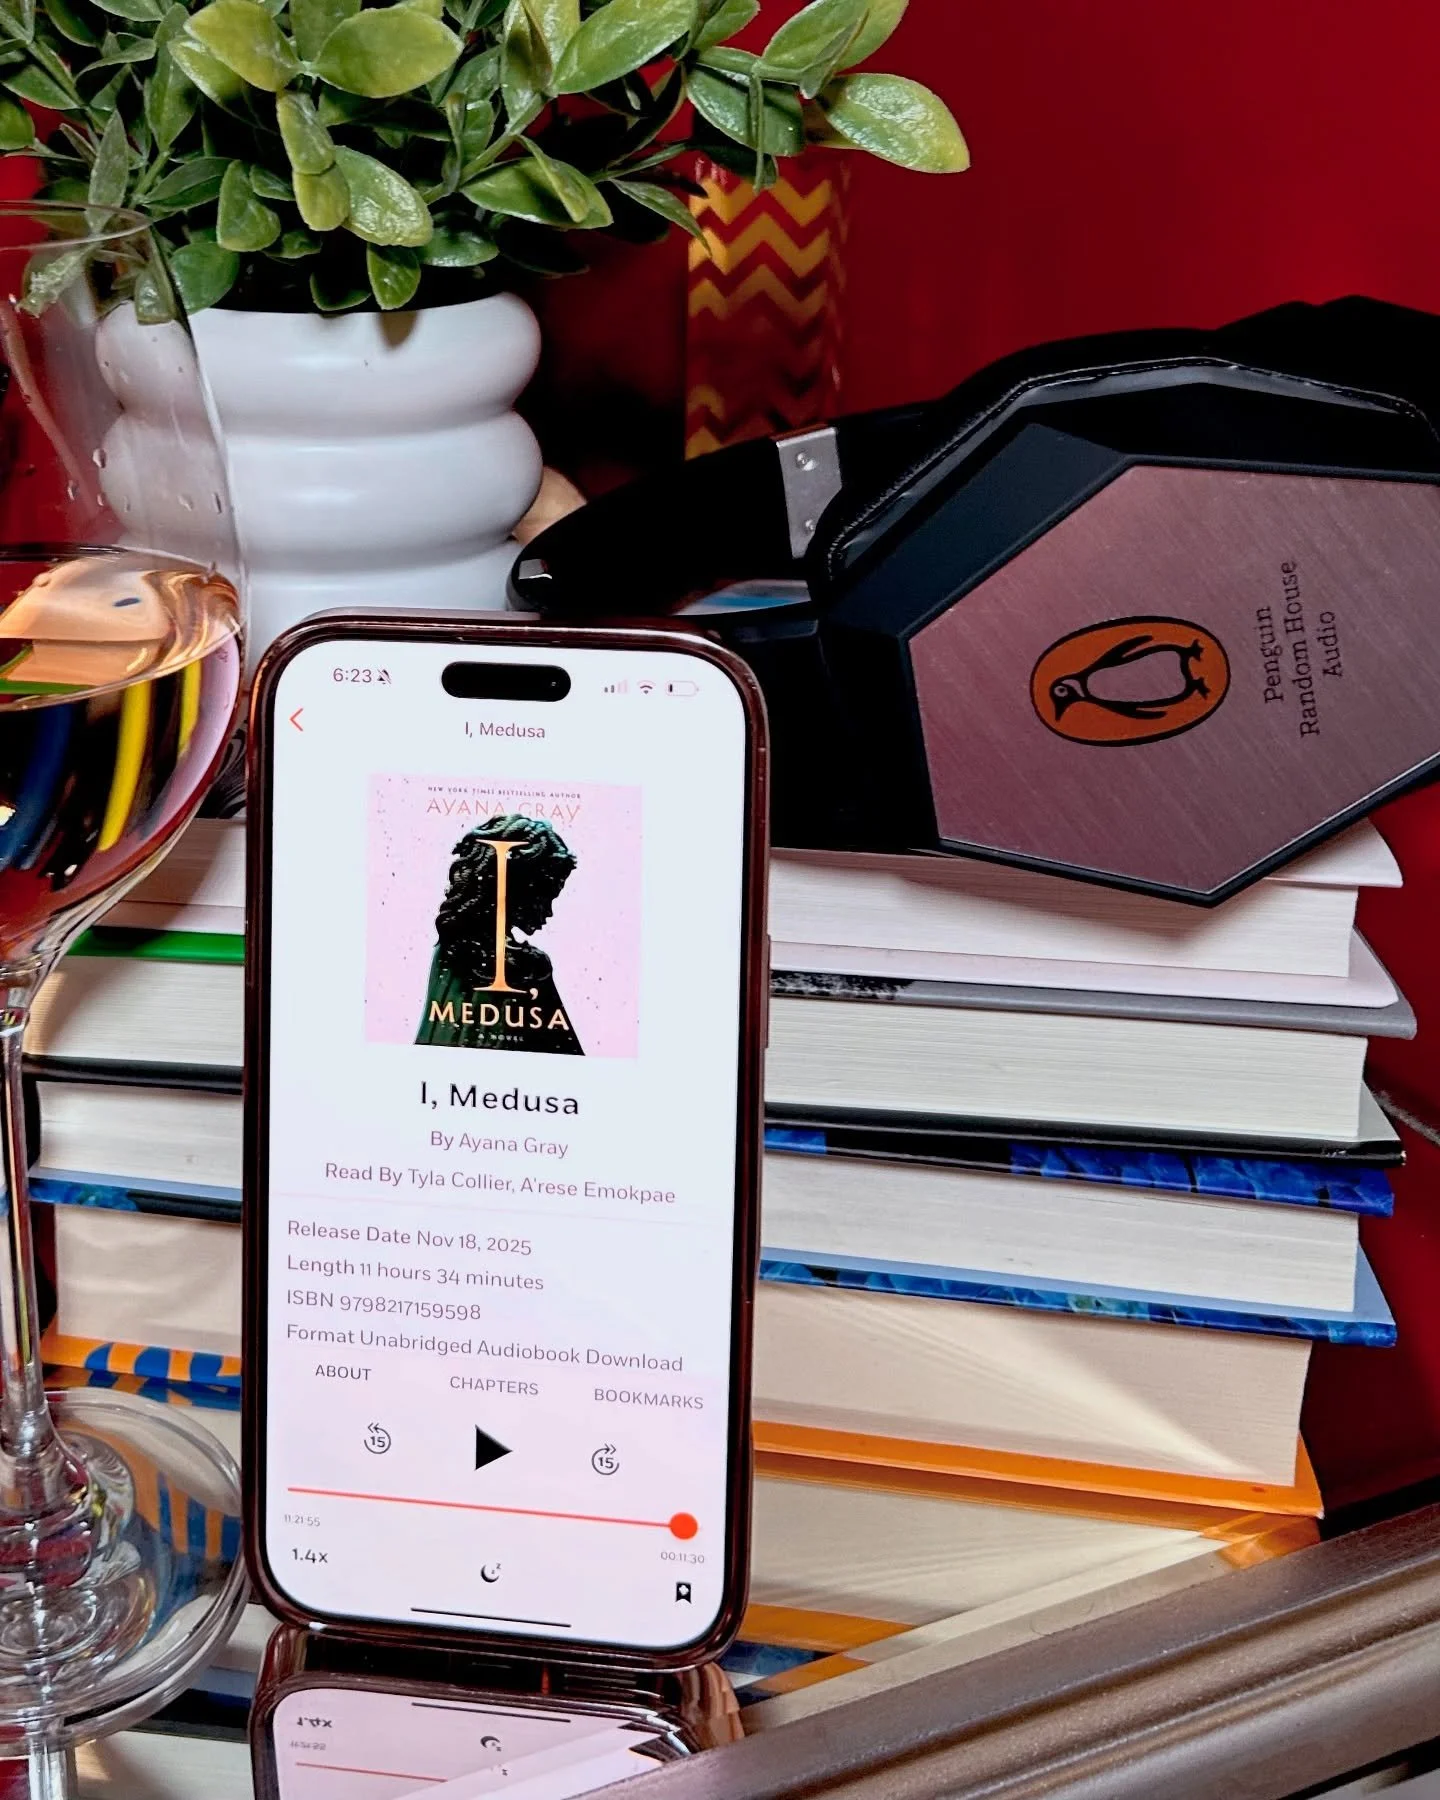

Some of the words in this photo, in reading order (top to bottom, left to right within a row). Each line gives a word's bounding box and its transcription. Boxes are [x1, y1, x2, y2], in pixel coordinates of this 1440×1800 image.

[1281, 560, 1305, 635] House
[1255, 605, 1284, 704] Penguin
[1316, 610, 1343, 678] Audio
[332, 667, 373, 684] 6:23
[1291, 639, 1321, 738] Random
[464, 721, 474, 739] I,
[479, 721, 546, 739] Medusa
[426, 798, 506, 817] AYANA
[428, 1000, 570, 1031] MEDUSA
[420, 1080, 438, 1110] I,
[449, 1082, 580, 1116] Medusa
[430, 1130, 455, 1151] By
[458, 1132, 518, 1153] Ayana
[523, 1136, 569, 1161] Gray
[325, 1162, 373, 1182] Read
[379, 1166, 403, 1187] By
[407, 1168, 446, 1189] Tyla
[451, 1171, 516, 1194] Collier,
[520, 1177, 579, 1198] A'rese
[584, 1181, 676, 1205] Emokpae
[288, 1219, 361, 1241] Release
[366, 1226, 411, 1245] Date
[417, 1229, 454, 1249] Nov
[458, 1234, 482, 1253] 18,
[486, 1237, 532, 1256] 2025
[287, 1254, 355, 1277] Length
[359, 1262, 372, 1277] 11
[377, 1261, 431, 1281] hours
[436, 1268, 461, 1286] 34
[466, 1273, 544, 1291] minutes
[287, 1289, 334, 1308] ISBN
[339, 1295, 481, 1321] 9798217159598
[287, 1323, 355, 1345] Format
[360, 1329, 472, 1356] Unabridged
[476, 1339, 580, 1364] Audiobook
[586, 1348, 683, 1373] Download
[315, 1364, 372, 1382] ABOUT
[449, 1375, 539, 1396] CHAPTERS
[594, 1388, 704, 1410] BOOKMARKS
[369, 1435, 386, 1449] 15
[597, 1456, 615, 1470] 15
[291, 1547, 329, 1564] 1.4x
